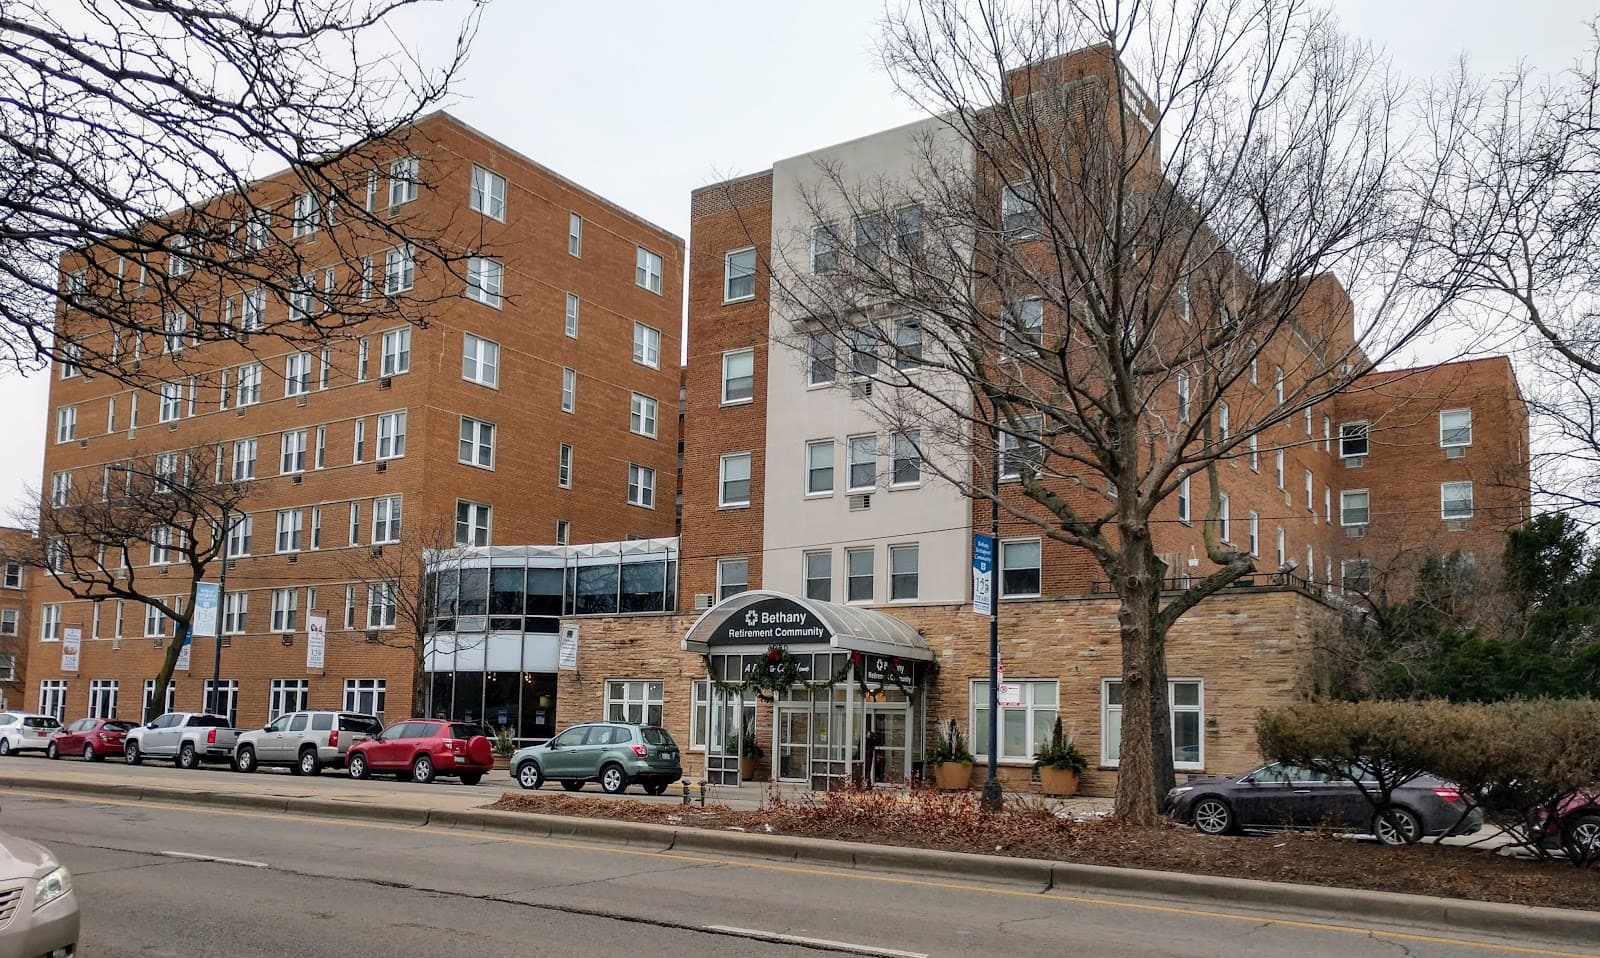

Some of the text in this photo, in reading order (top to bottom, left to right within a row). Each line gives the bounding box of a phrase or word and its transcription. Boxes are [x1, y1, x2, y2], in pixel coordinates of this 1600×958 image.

[761, 611, 807, 625] Bethany
[728, 627, 824, 638] Retirement Community
